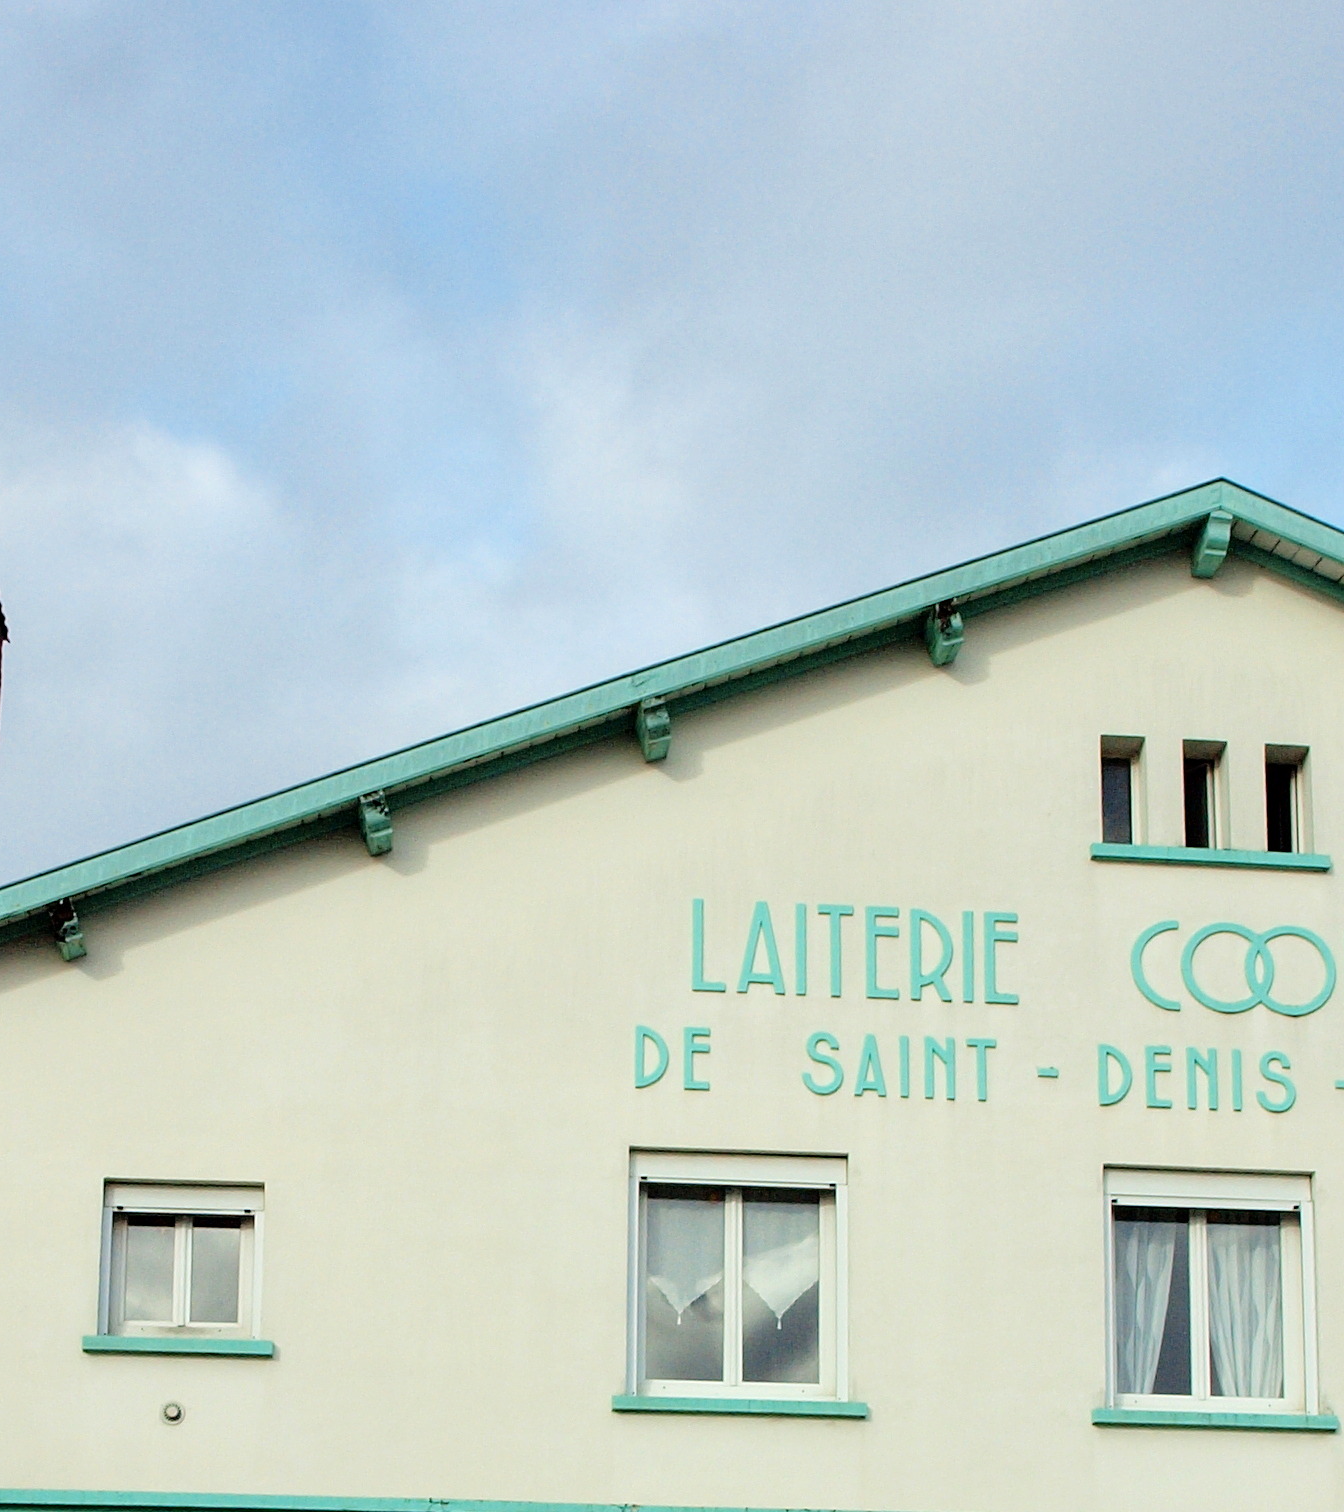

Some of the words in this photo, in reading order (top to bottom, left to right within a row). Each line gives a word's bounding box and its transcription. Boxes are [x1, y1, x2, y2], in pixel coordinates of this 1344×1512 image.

[692, 898, 1020, 1005] LAITERIE
[635, 1025, 712, 1091] DE
[802, 1031, 998, 1102] SAINT
[1098, 1044, 1297, 1114] DENIS
